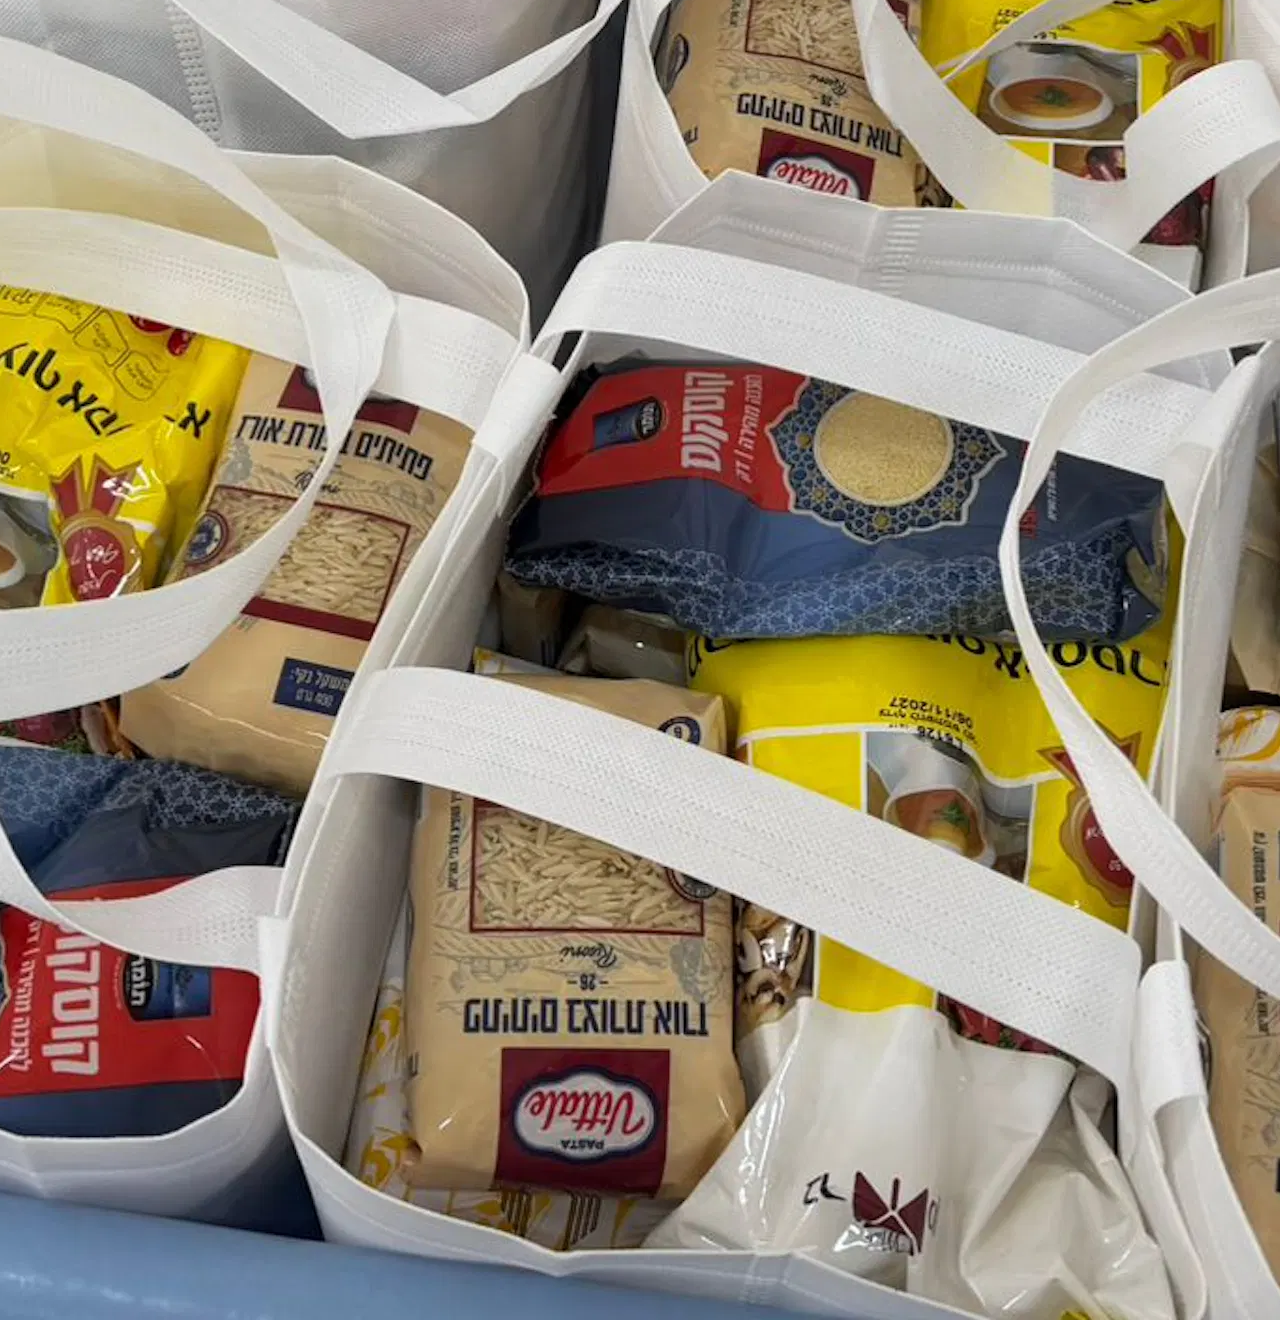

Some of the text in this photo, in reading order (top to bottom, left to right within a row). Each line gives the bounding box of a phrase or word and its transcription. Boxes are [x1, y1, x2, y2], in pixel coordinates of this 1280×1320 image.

[735, 93, 904, 159] פתיתים בצורת אורז
[234, 414, 286, 443] אורז
[679, 371, 735, 473] קוסקוס
[736, 405, 763, 450] מהירה
[353, 431, 435, 481] פתיתים
[732, 459, 753, 484] דק
[557, 943, 618, 969] Risoni
[14, 959, 38, 1013] מהירה
[42, 923, 102, 1077] קוסקו
[461, 997, 710, 1038] פתיתים בצורת אורז
[6, 1015, 34, 1074] להכנה
[524, 1088, 646, 1137] Vittale
[559, 1137, 606, 1153] PASTA
